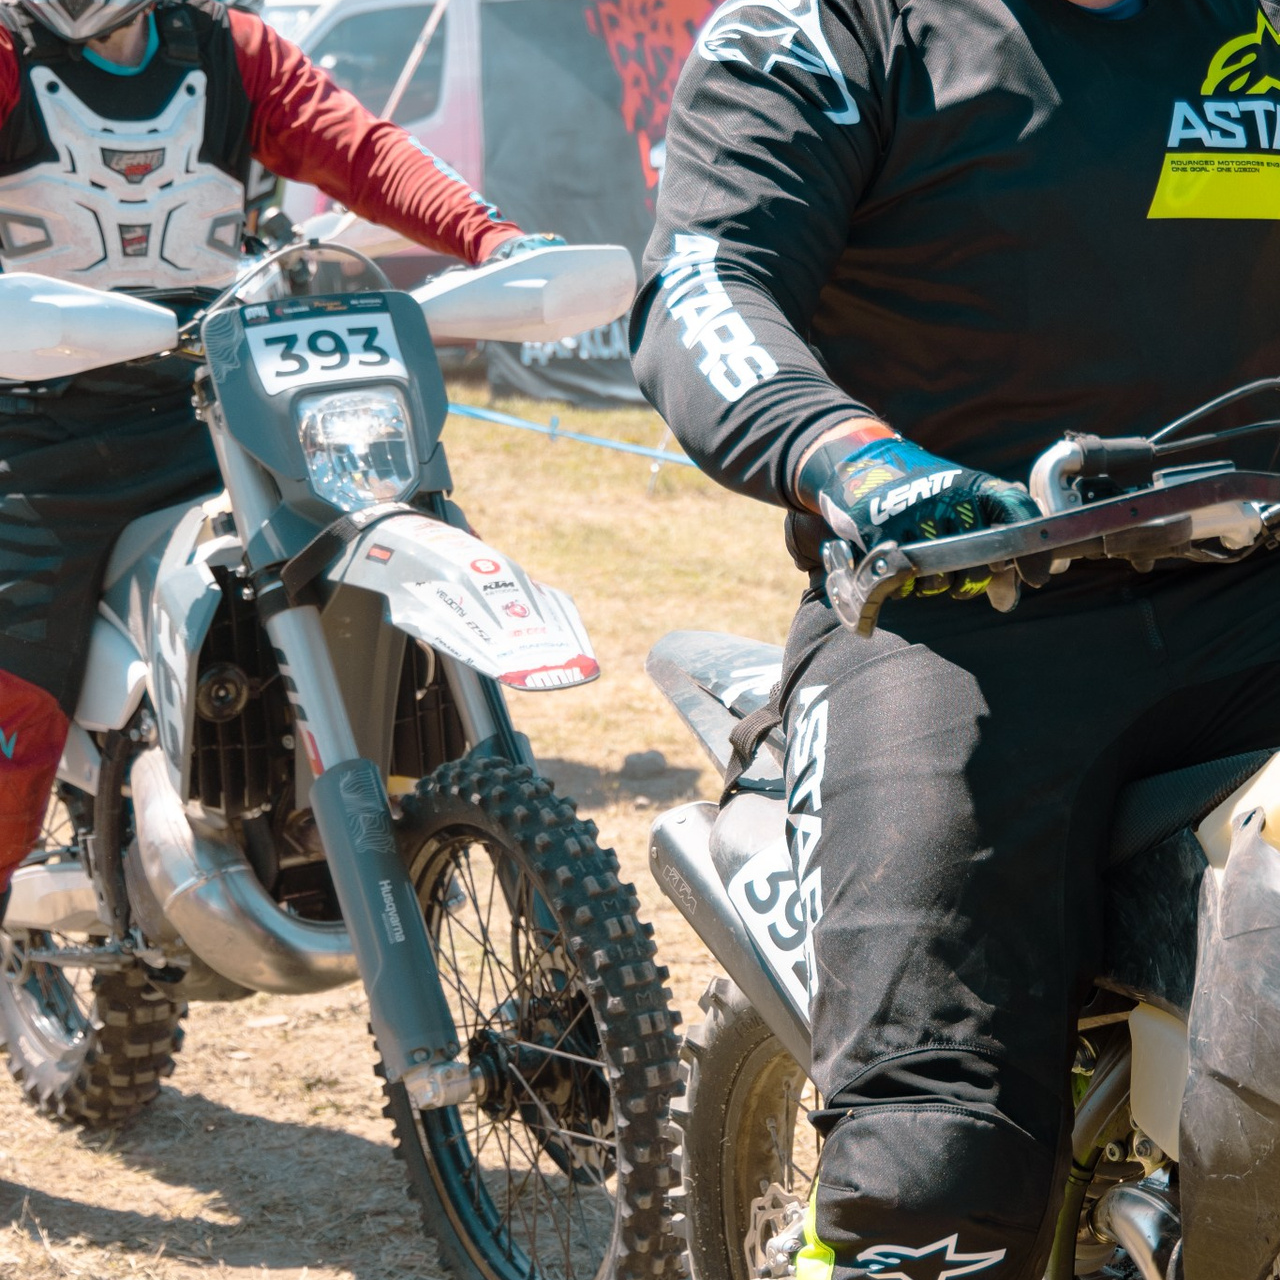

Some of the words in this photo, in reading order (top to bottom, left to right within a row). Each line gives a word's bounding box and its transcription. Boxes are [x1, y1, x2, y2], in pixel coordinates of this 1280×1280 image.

[263, 327, 390, 378] 393
[870, 469, 963, 526] LEATT
[436, 587, 467, 618] VELOCITY
[482, 580, 516, 592] KTM
[379, 879, 406, 943] Husqvarna
[663, 864, 697, 916] KTM
